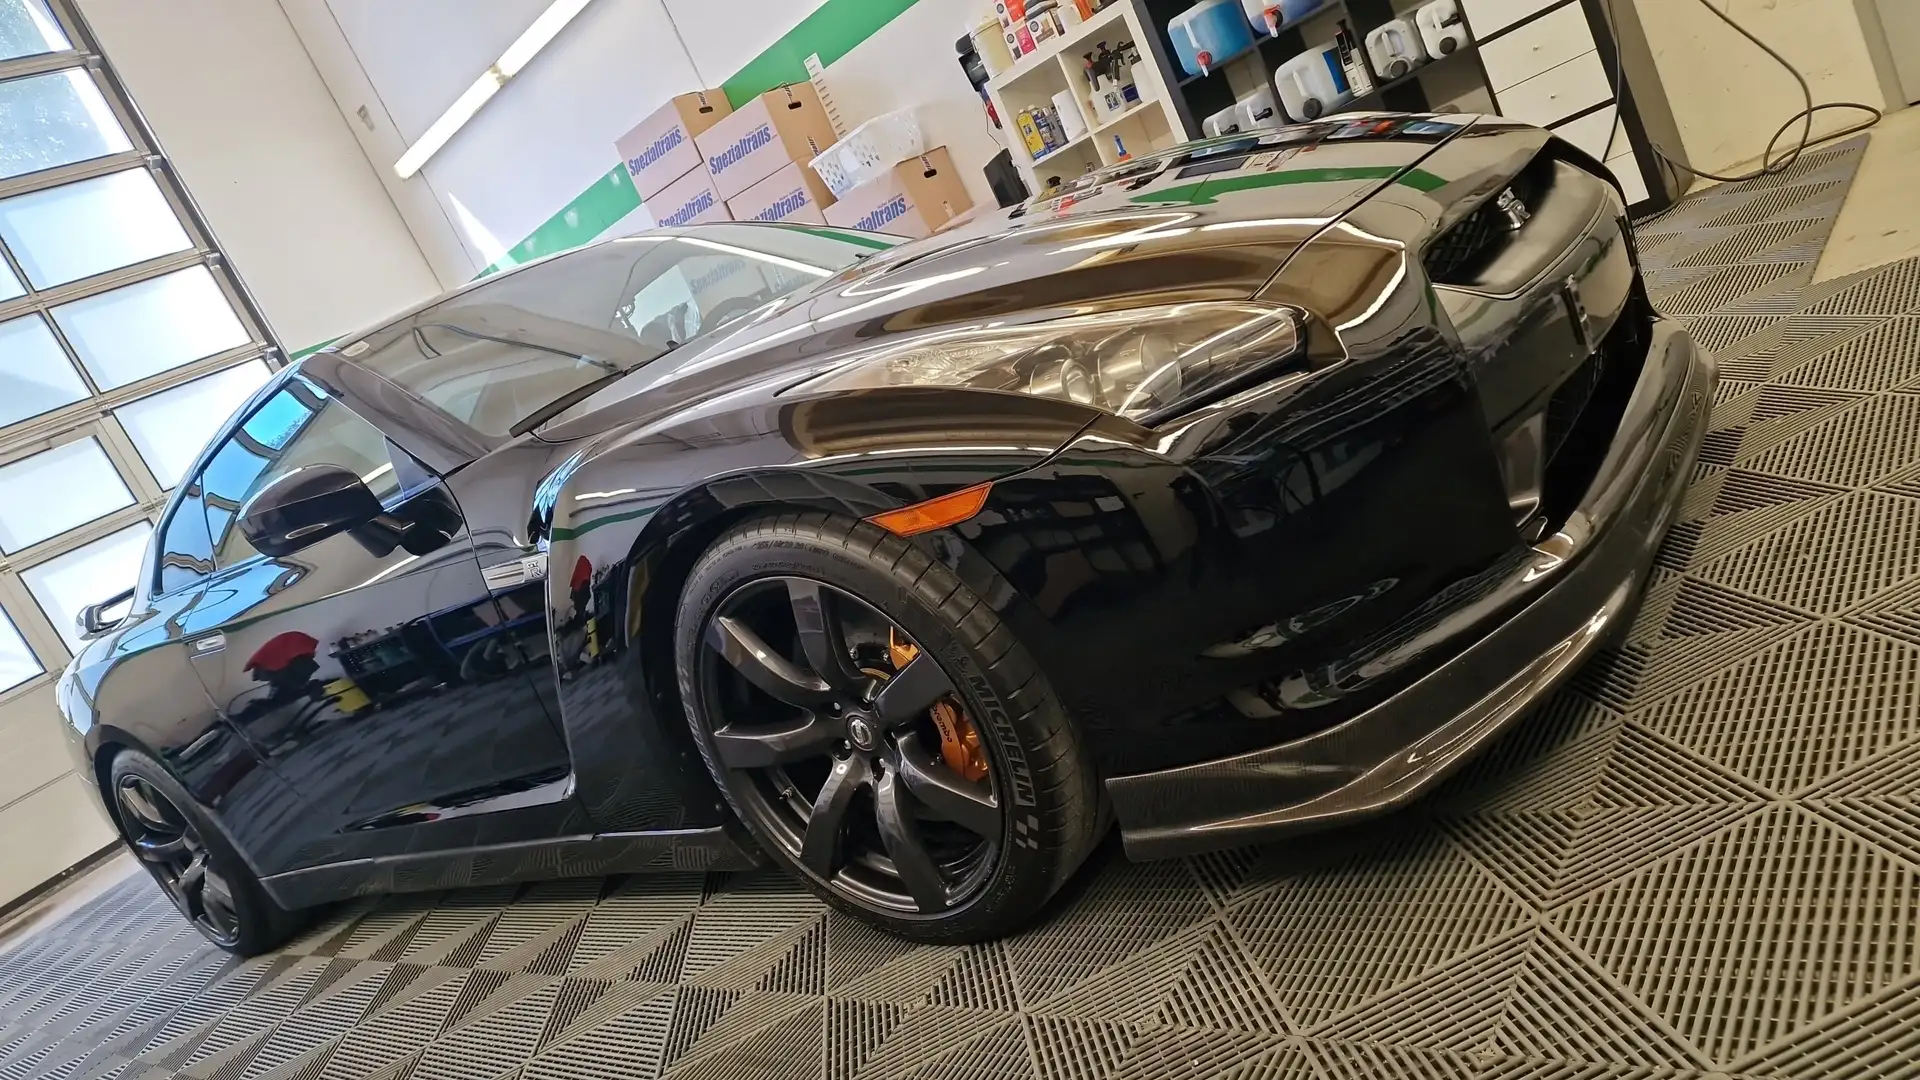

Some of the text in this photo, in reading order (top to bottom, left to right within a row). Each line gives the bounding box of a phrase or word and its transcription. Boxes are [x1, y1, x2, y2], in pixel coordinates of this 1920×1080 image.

[628, 128, 682, 177] Spezialtrans
[709, 125, 771, 175] Spezialtrans
[743, 190, 806, 221] zialtrans
[851, 197, 907, 231] zialtrans
[933, 703, 953, 743] brembo
[969, 675, 1037, 807] MICHELIN
